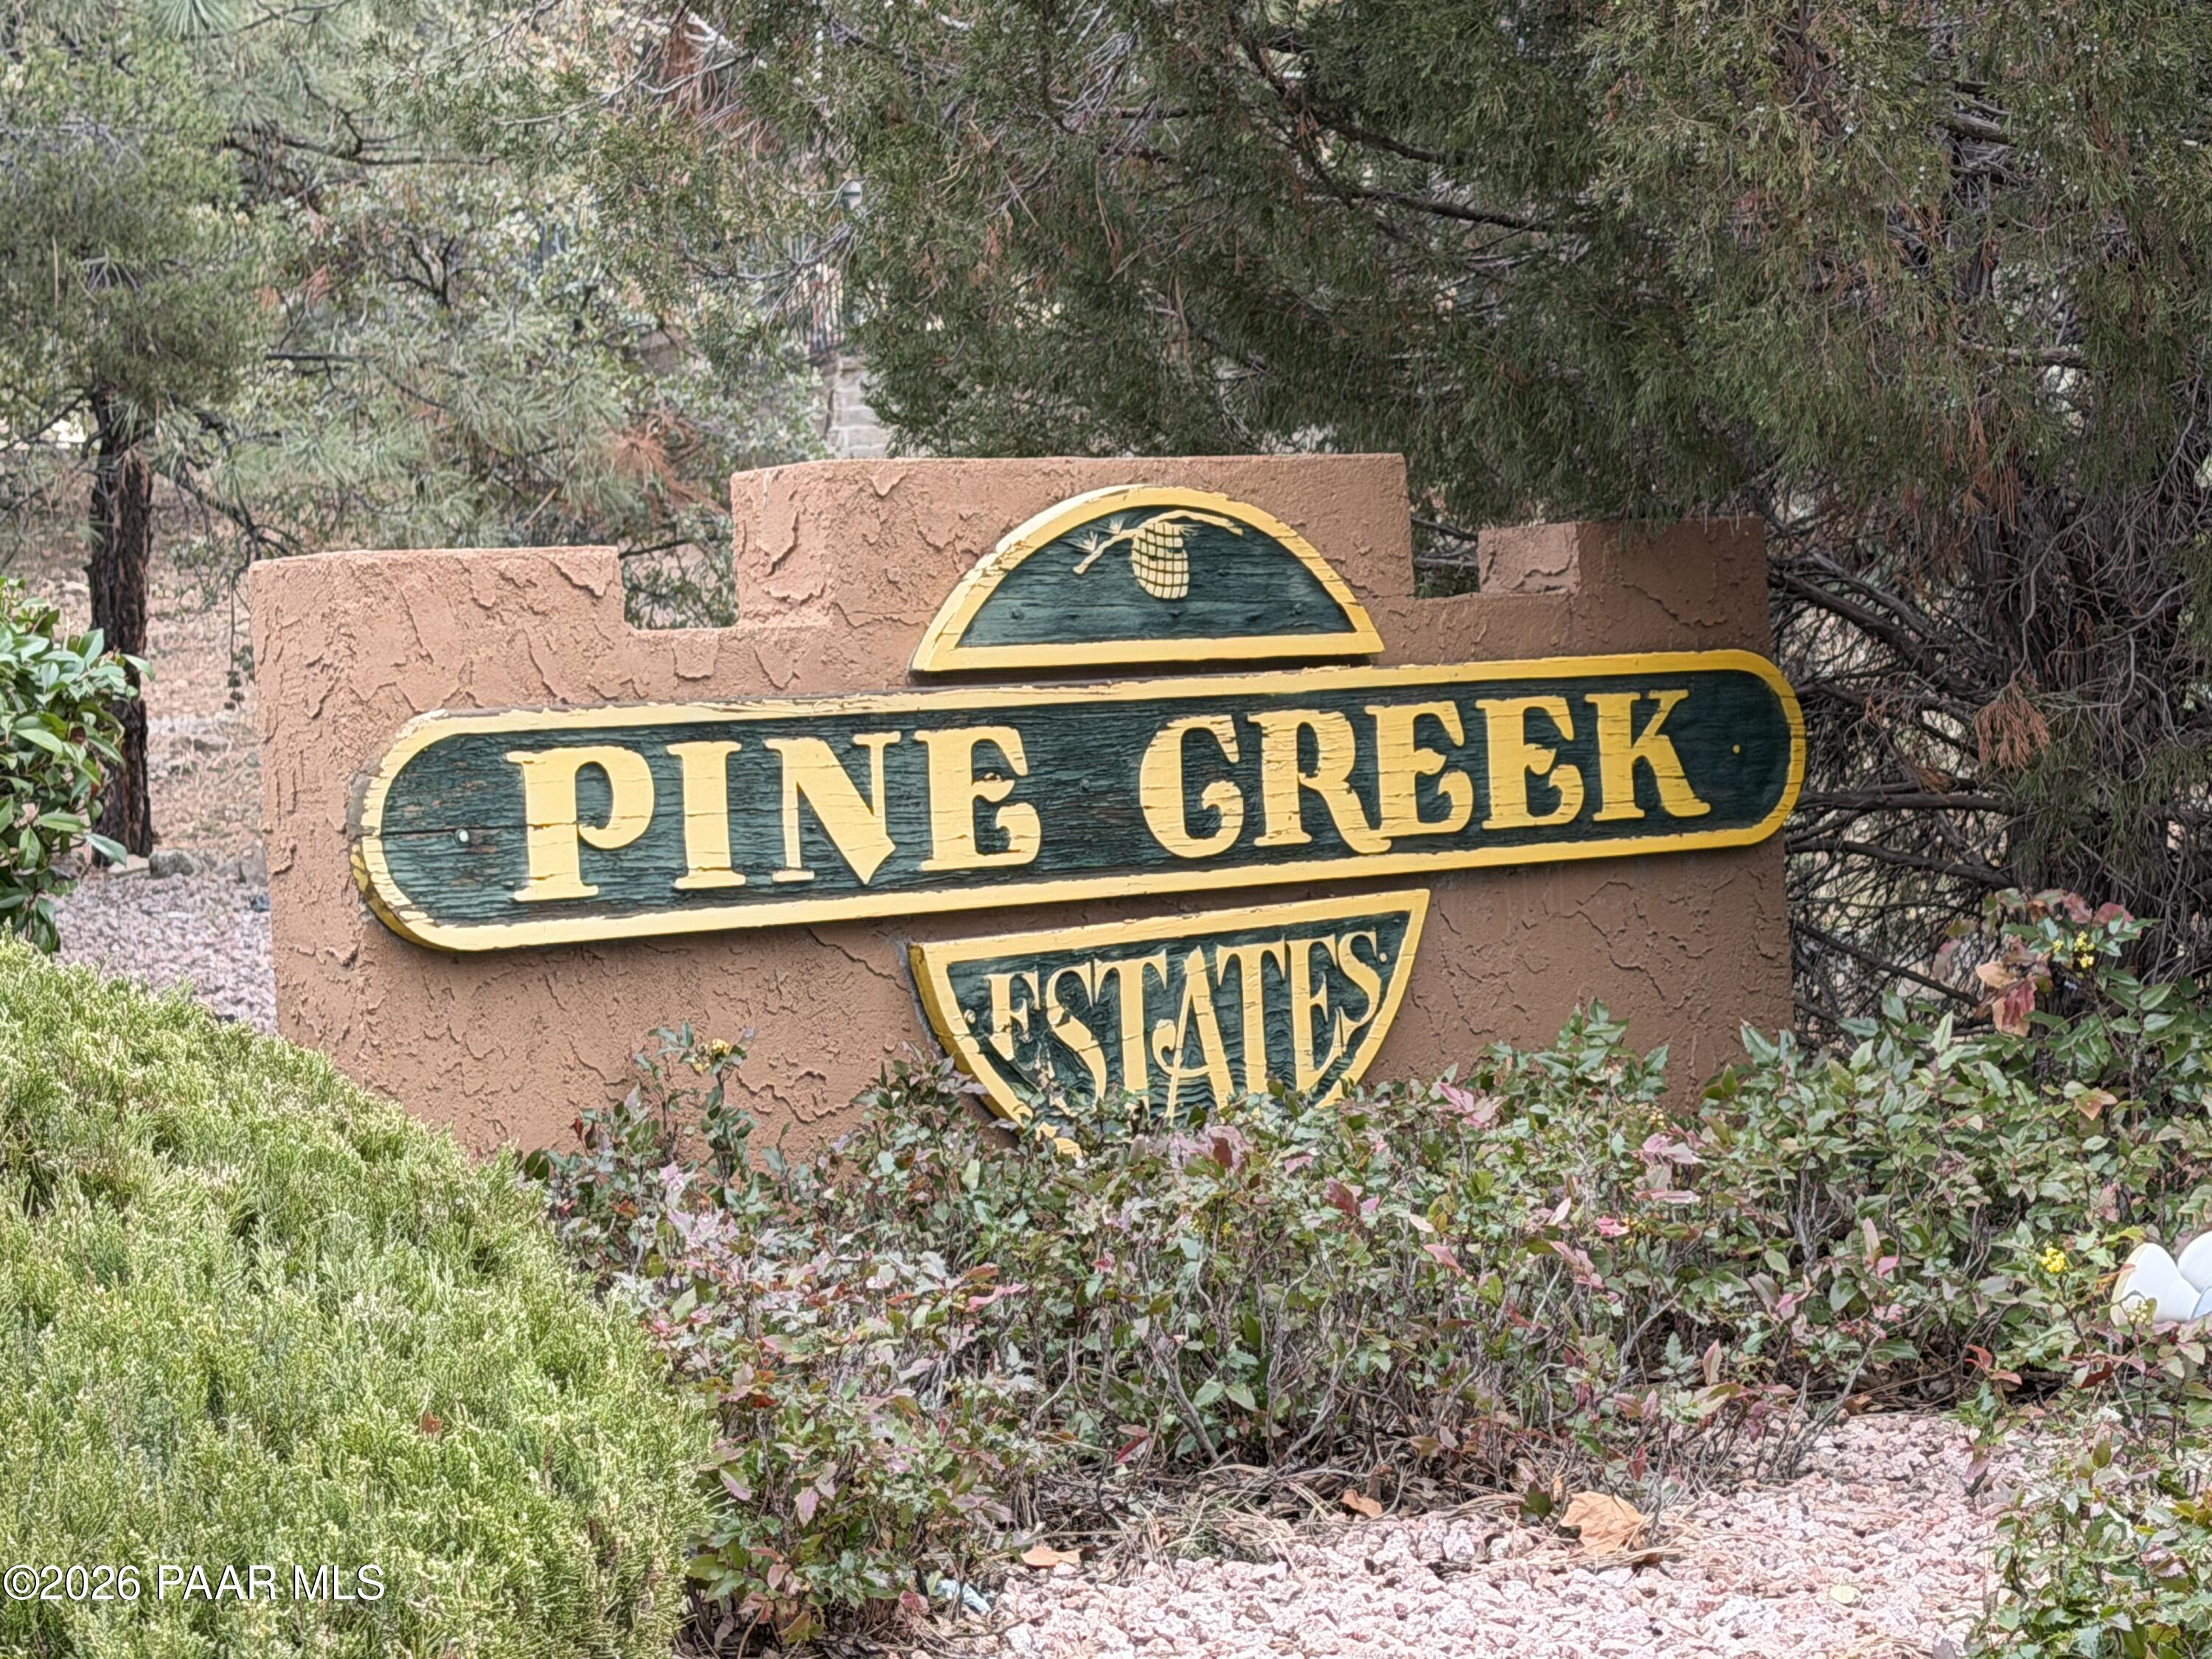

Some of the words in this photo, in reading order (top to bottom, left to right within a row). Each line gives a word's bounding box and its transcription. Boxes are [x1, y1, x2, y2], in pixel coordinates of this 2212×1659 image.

[506, 726, 1041, 902] PINE
[1139, 689, 1711, 858] CREEK
[985, 931, 1383, 1125] ESTATES
